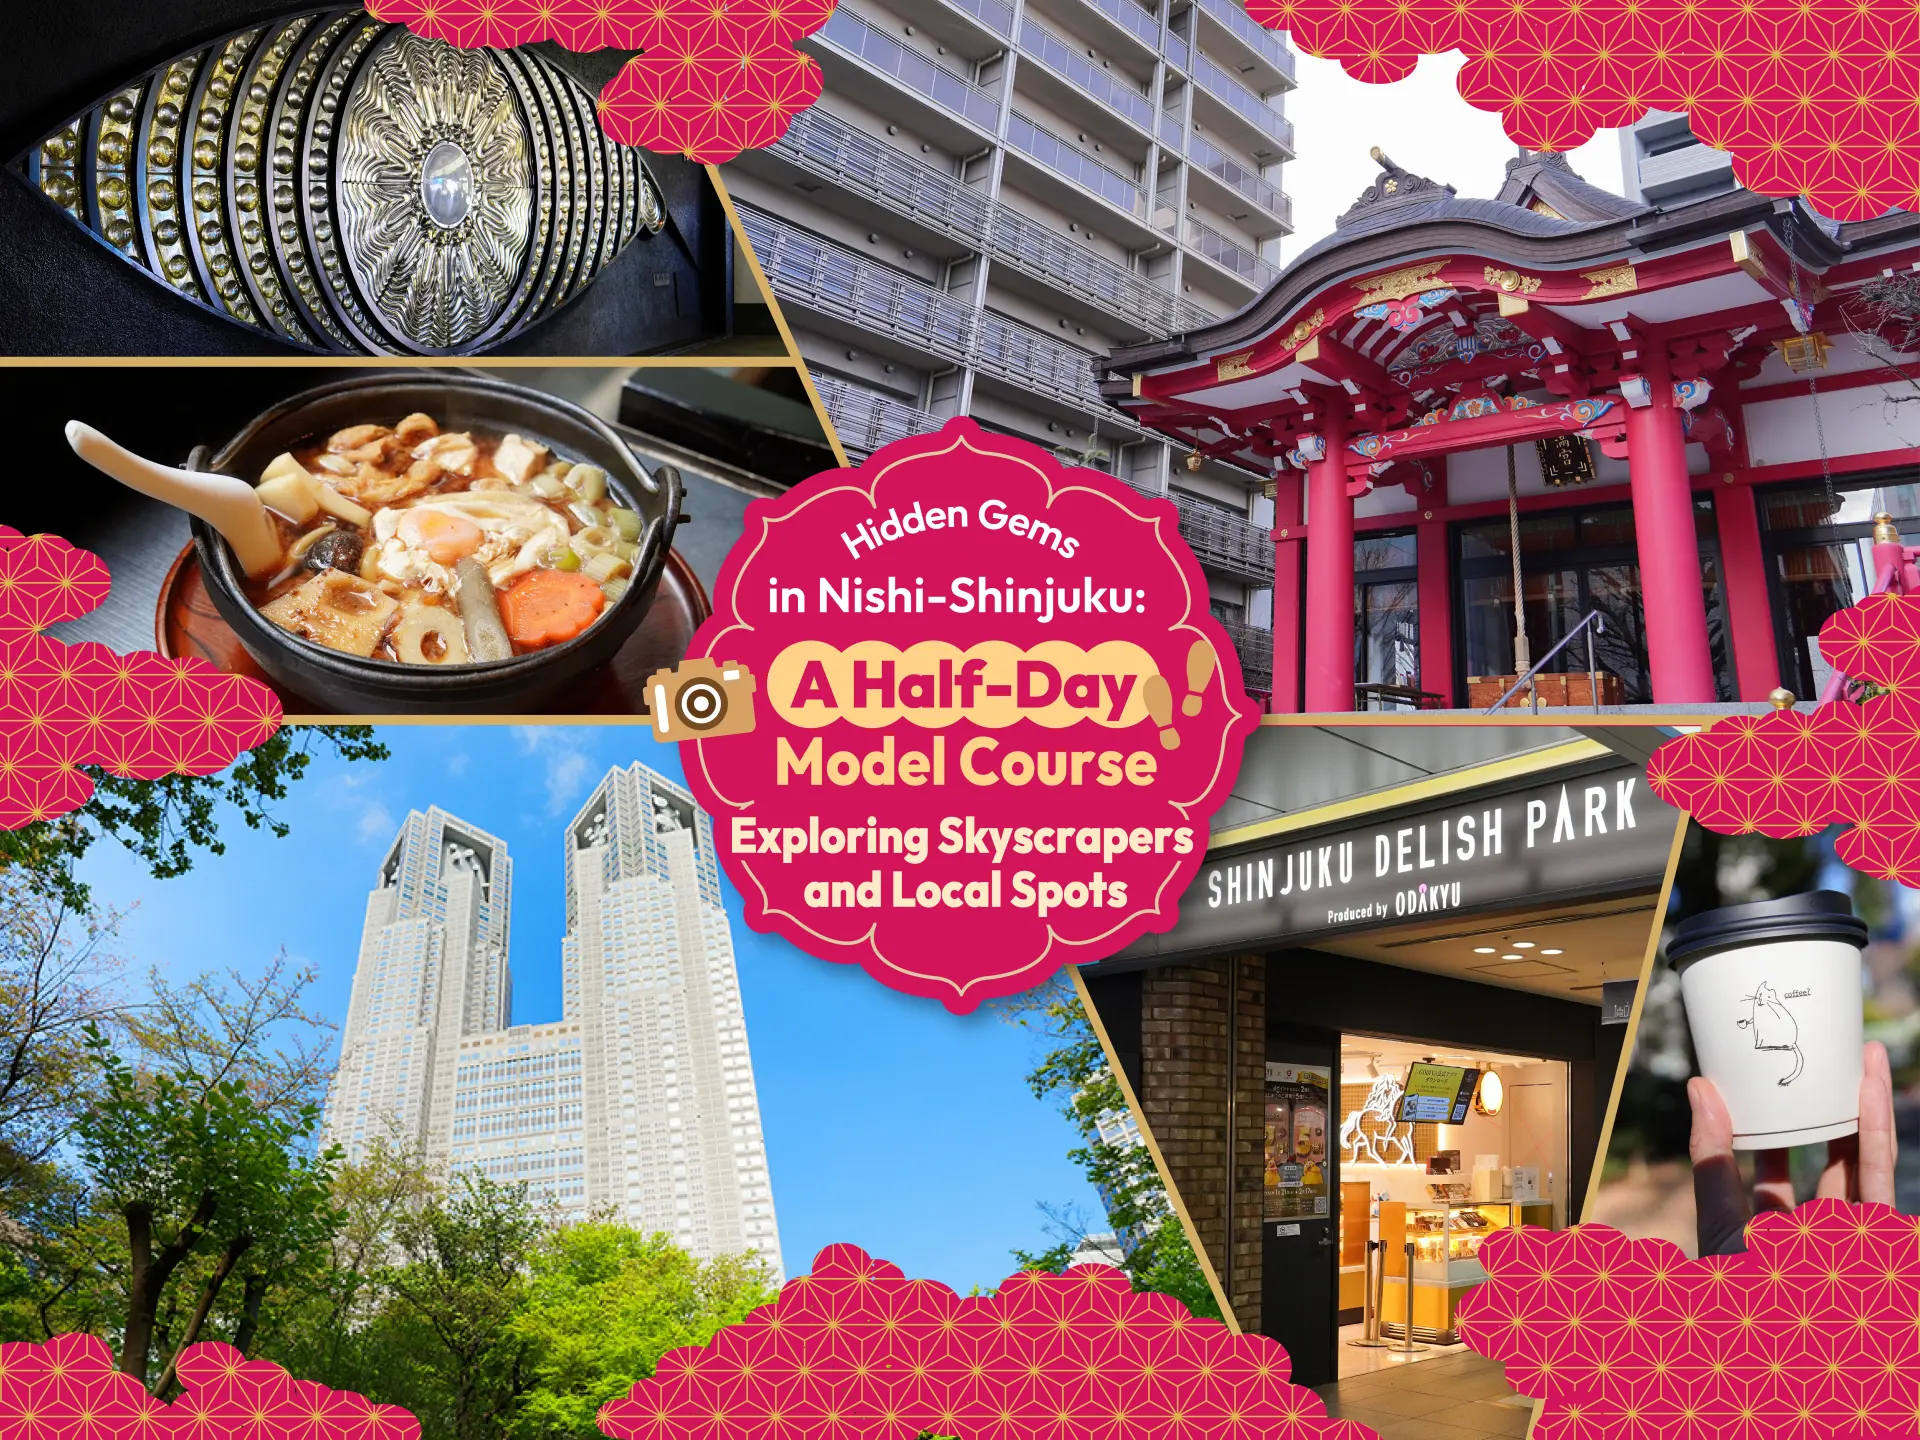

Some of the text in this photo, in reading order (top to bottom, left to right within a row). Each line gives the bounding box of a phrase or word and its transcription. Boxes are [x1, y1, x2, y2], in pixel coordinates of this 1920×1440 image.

[1208, 777, 1638, 909] SHINJUKU DELISH PARK
[1327, 882, 1461, 924] Produced by ODAKYU
[1784, 987, 1812, 999] coffee?
